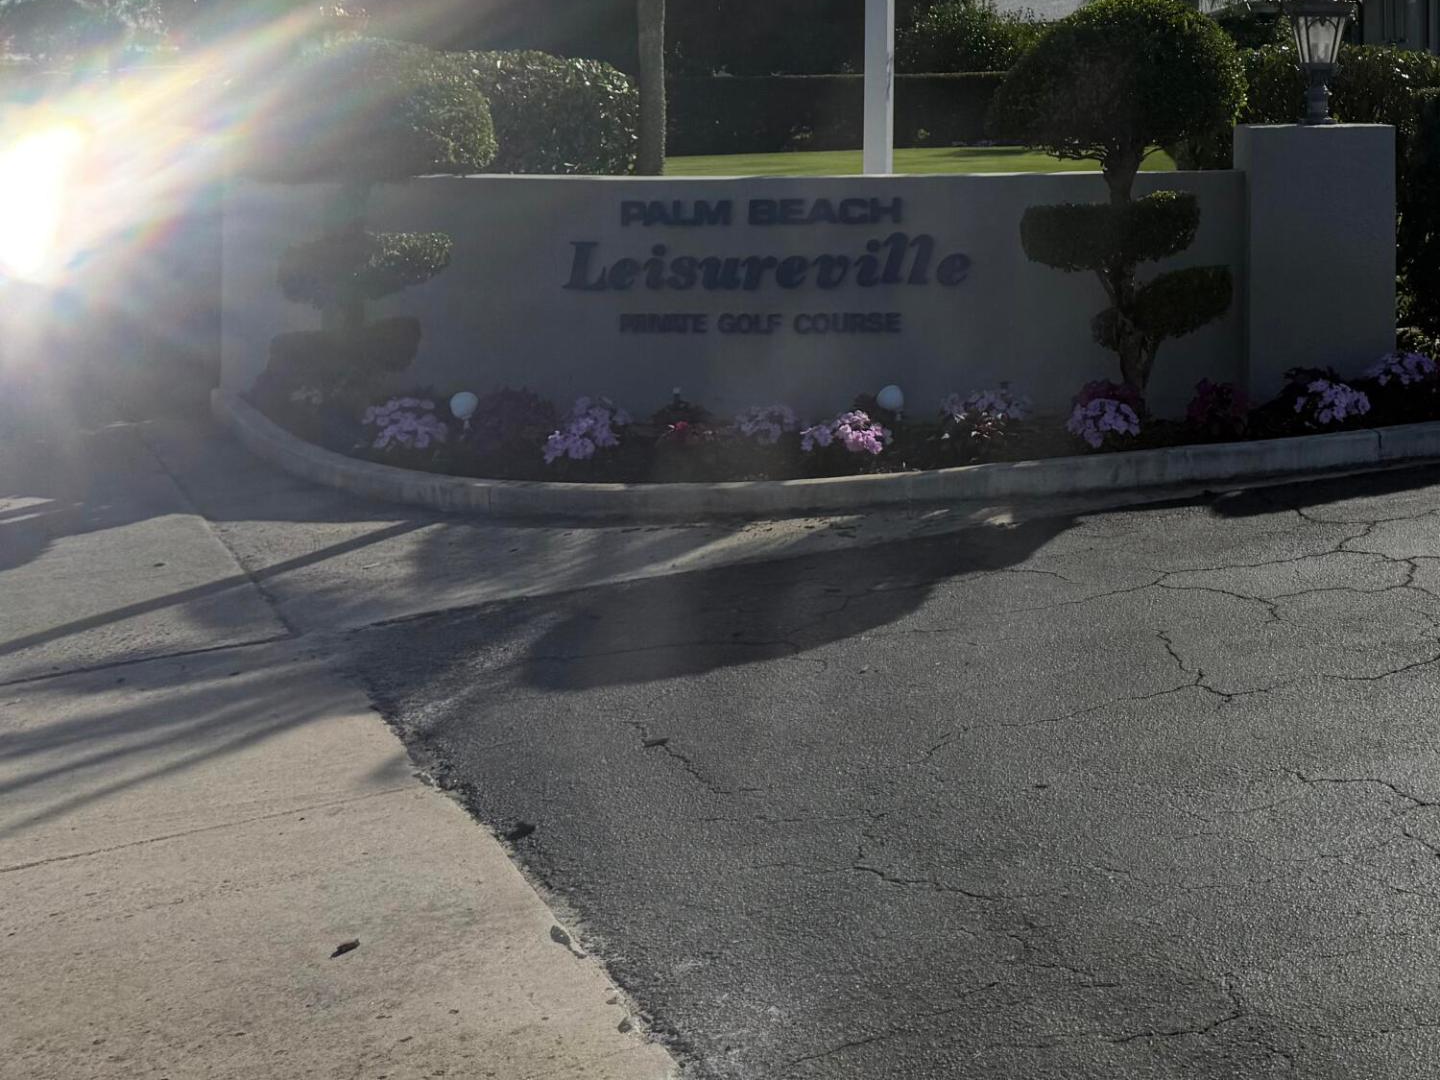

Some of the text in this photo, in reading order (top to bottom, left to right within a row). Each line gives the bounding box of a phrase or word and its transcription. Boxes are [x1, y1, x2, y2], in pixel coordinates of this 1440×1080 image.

[620, 197, 902, 226] PALM BEACH
[562, 231, 972, 291] Leisureville
[620, 312, 902, 333] PRIVATE GOLF COURSE
